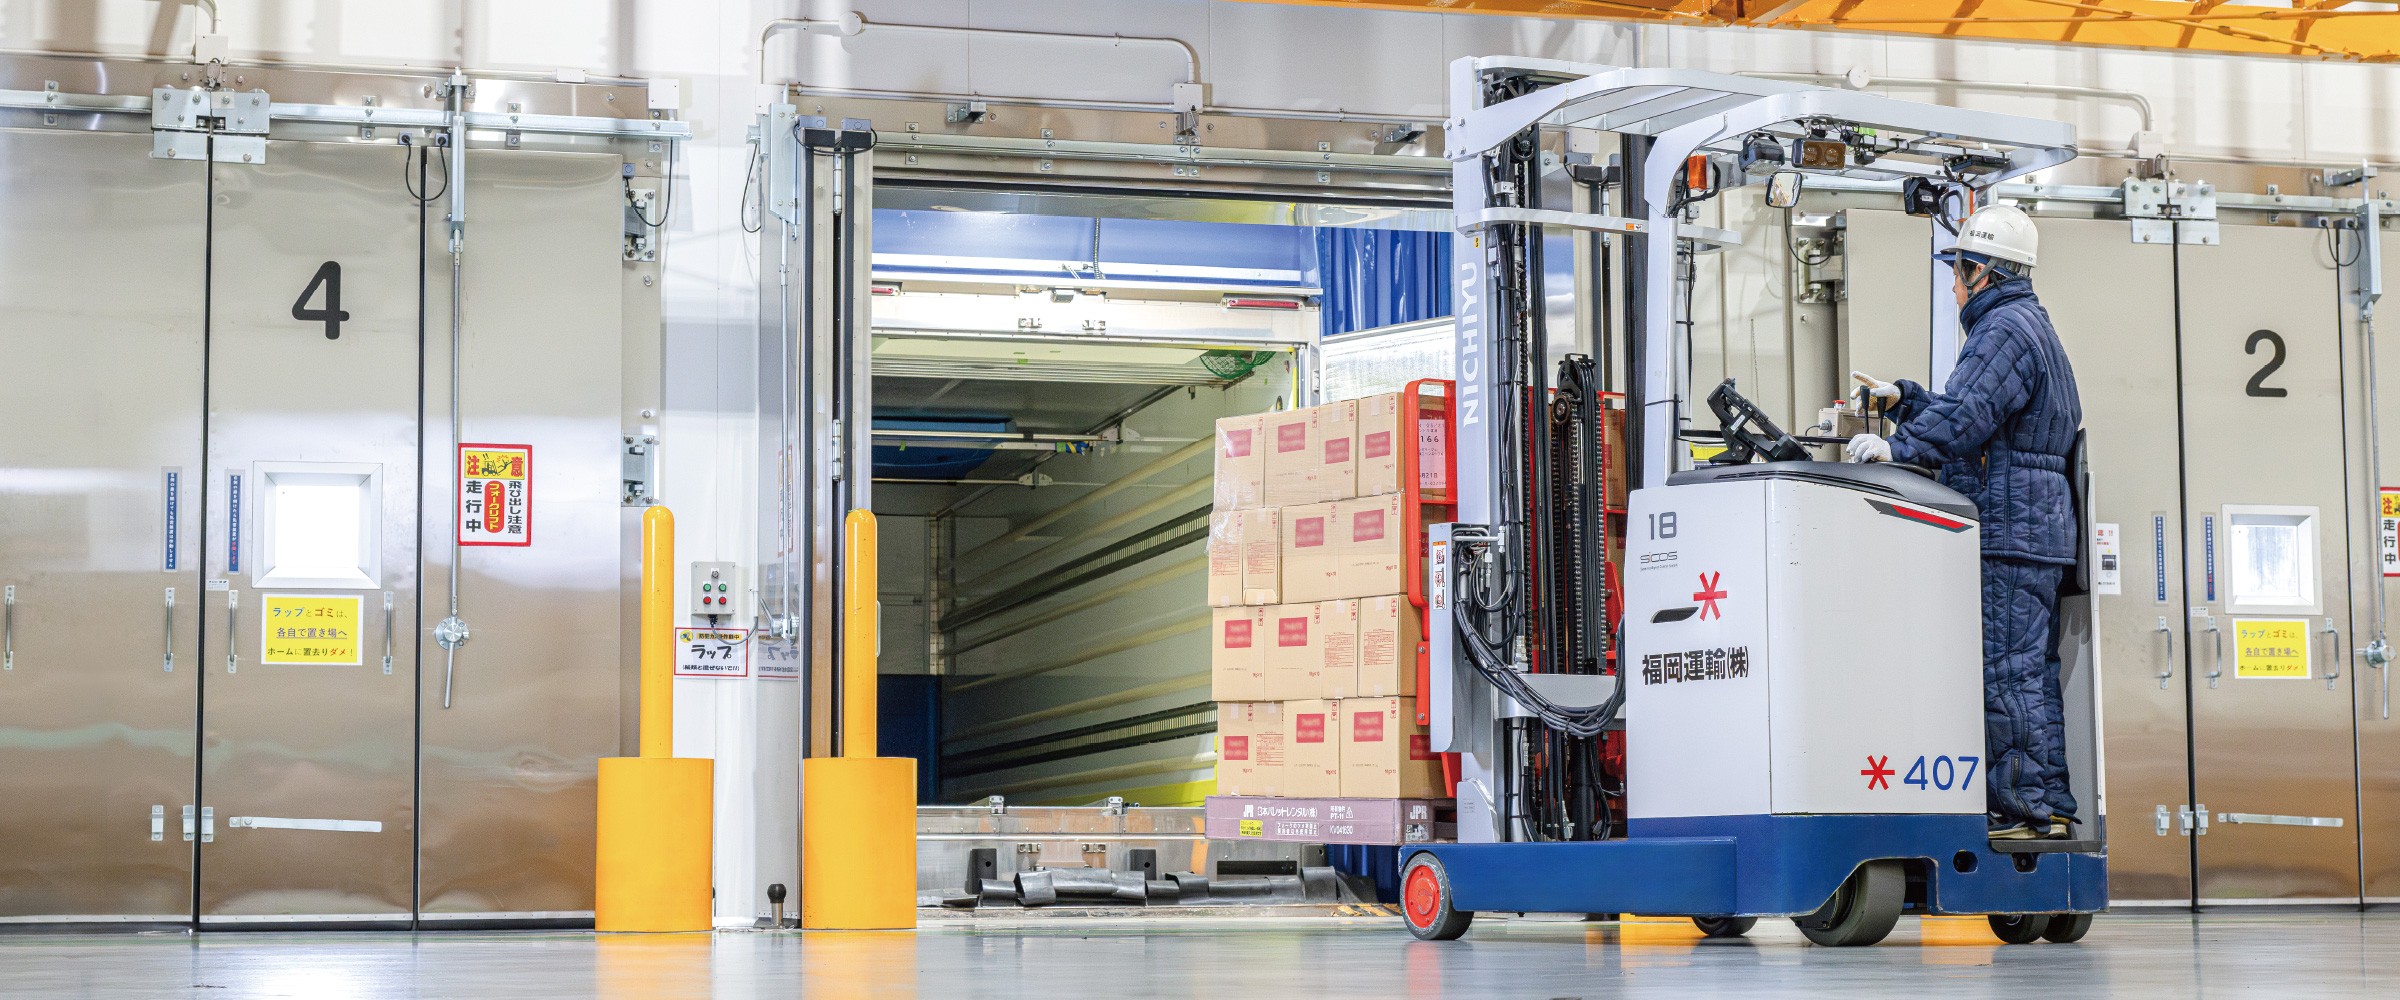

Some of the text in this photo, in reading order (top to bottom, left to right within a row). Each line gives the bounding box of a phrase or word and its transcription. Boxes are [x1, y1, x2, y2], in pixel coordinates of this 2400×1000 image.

[292, 261, 349, 340] 4
[1462, 261, 1479, 428] NICHIYU
[2245, 330, 2288, 397] 2
[467, 455, 523, 477] 注 意
[466, 480, 483, 533] 走行中
[488, 483, 501, 530] フォークリフト
[508, 481, 523, 534] 飛び出し注意
[2383, 497, 2393, 515] 注
[1649, 511, 1677, 541] 18
[2383, 519, 2397, 565] 走行中
[277, 627, 348, 638] 各自で置き場へ
[691, 644, 733, 660] ラップ
[1642, 646, 1749, 686] 福岡運輸(株)
[2245, 647, 2299, 657] 各自で置き場へ
[1903, 755, 1980, 791] 407
[1410, 805, 1428, 820] JPR
